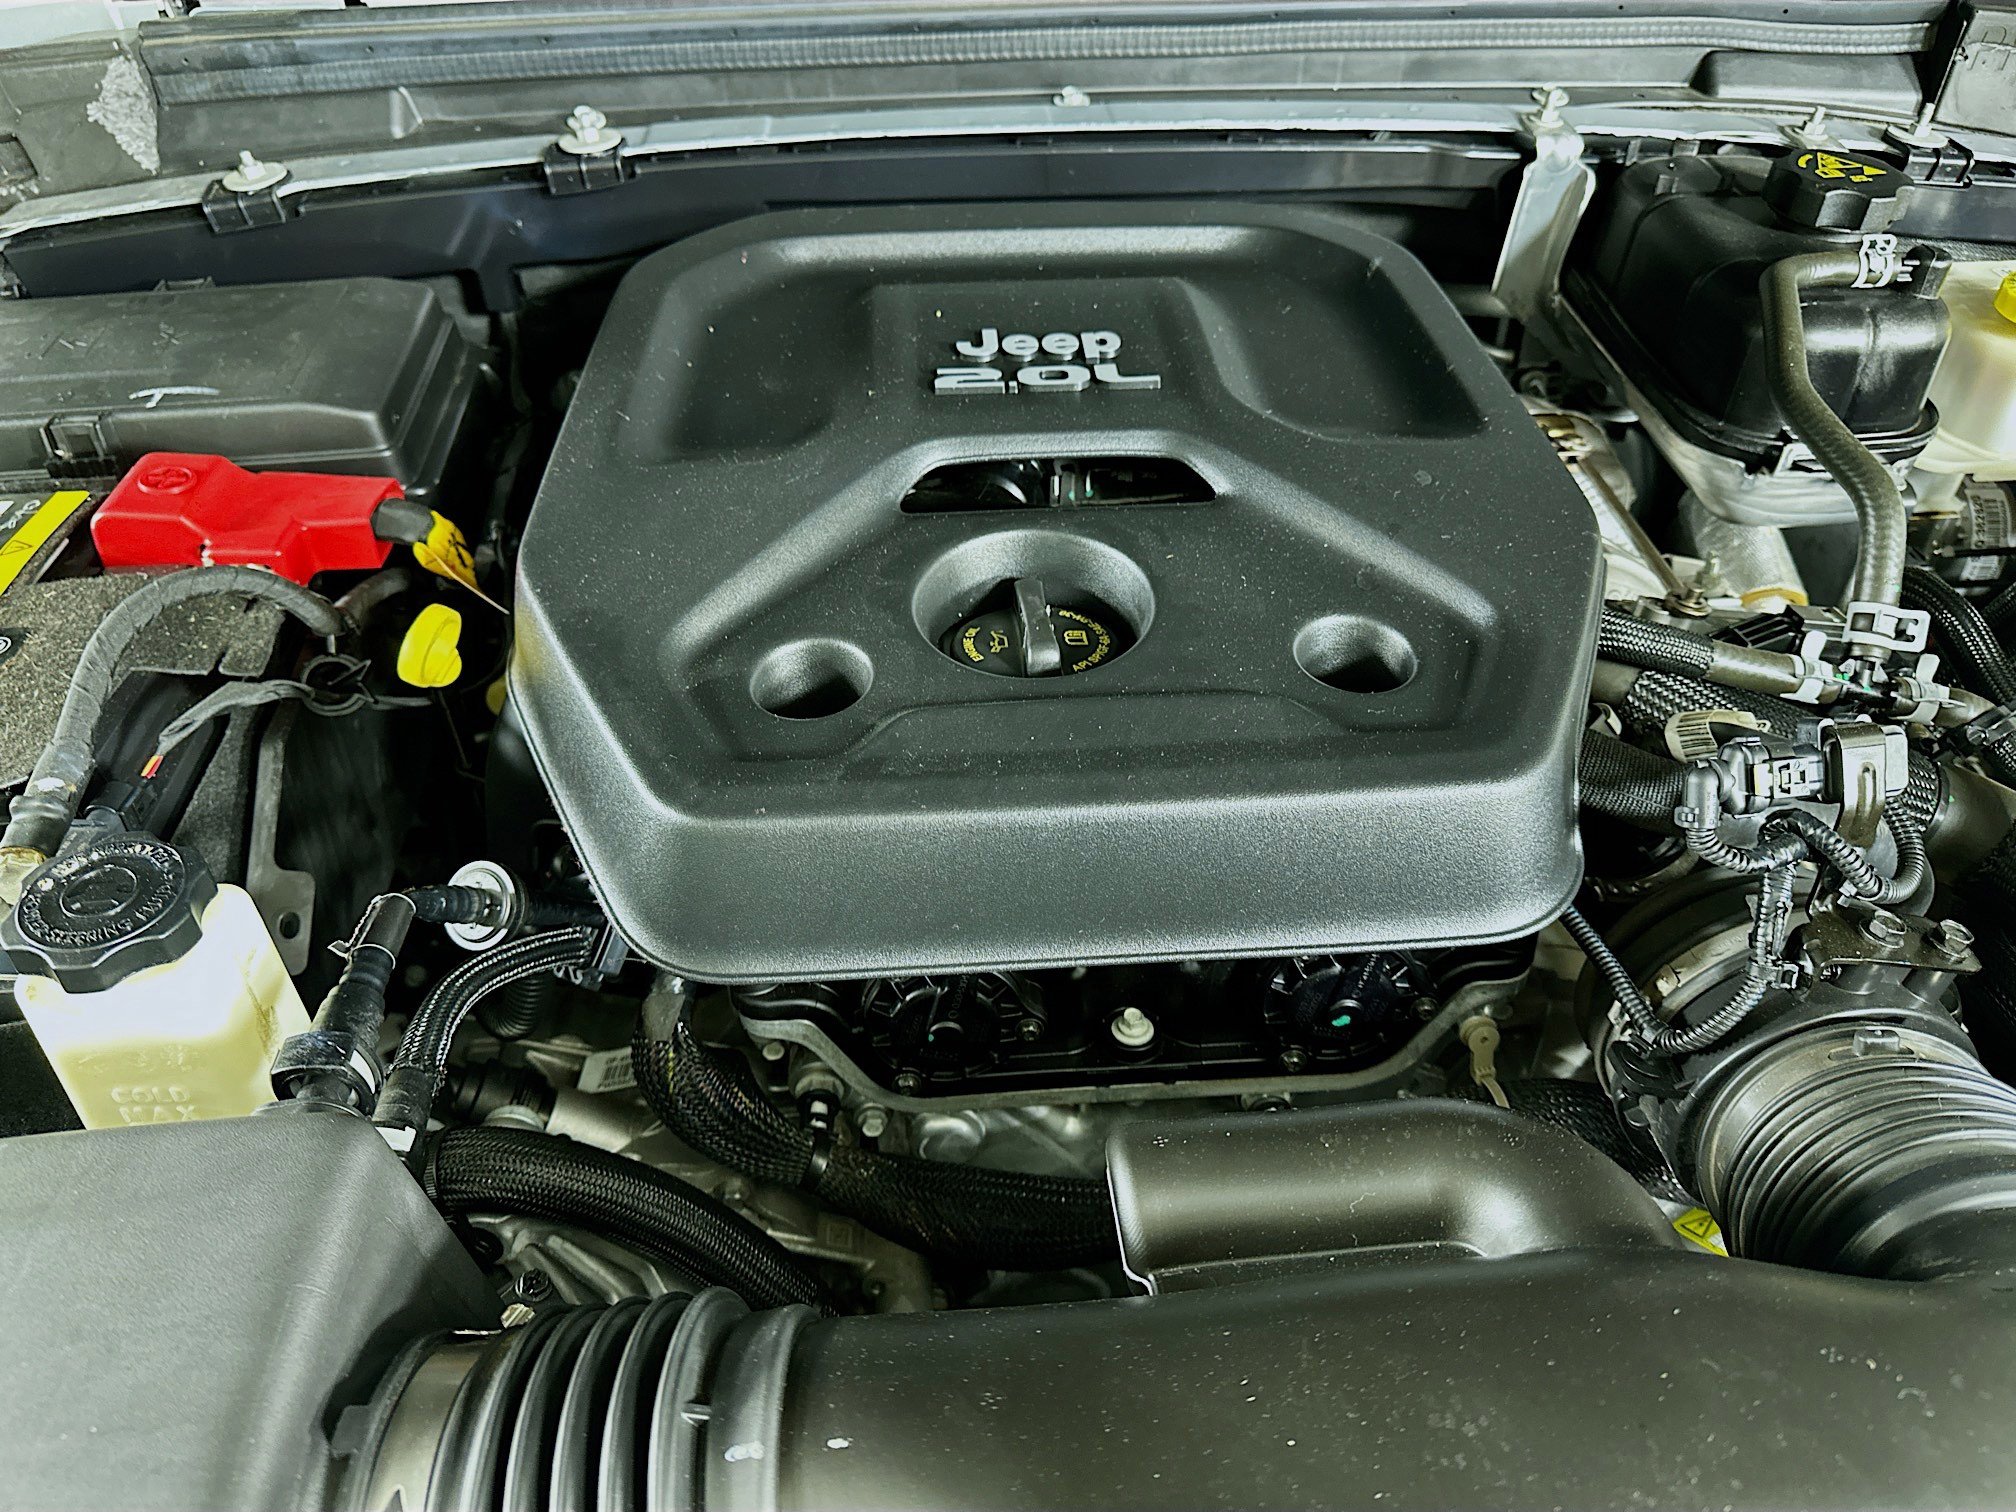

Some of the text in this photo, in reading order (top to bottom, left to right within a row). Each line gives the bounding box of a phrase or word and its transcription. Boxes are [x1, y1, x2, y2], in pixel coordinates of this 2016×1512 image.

[956, 328, 1122, 364] Jeep
[934, 363, 1162, 394] 2.0L
[963, 627, 984, 662] ENGINE OIL
[1072, 660, 1092, 671] API
[111, 1086, 191, 1104] COLD
[119, 1105, 195, 1125] MAX
